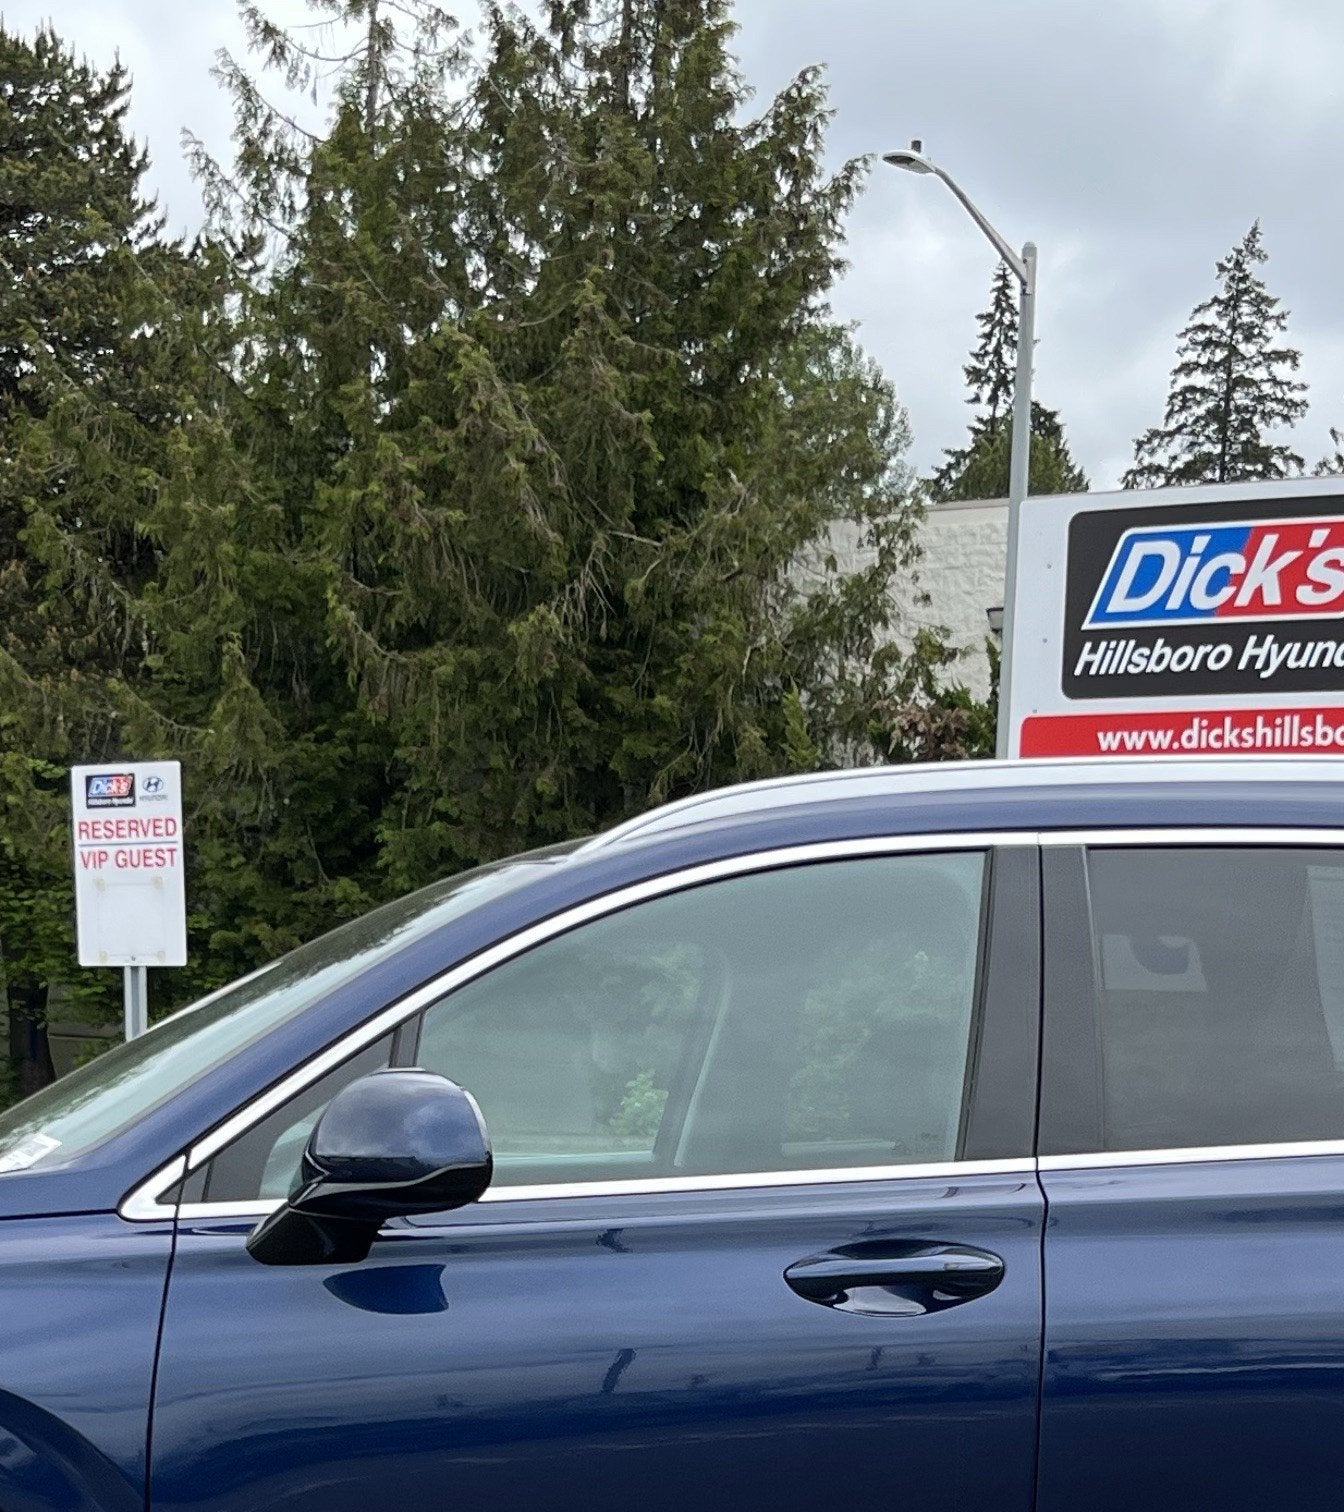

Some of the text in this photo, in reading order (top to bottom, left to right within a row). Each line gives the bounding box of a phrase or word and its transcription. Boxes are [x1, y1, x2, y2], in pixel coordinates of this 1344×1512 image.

[1074, 638, 1233, 676] Hillsboro
[78, 818, 177, 840] RESERVED
[80, 848, 177, 869] VIP GUEST
